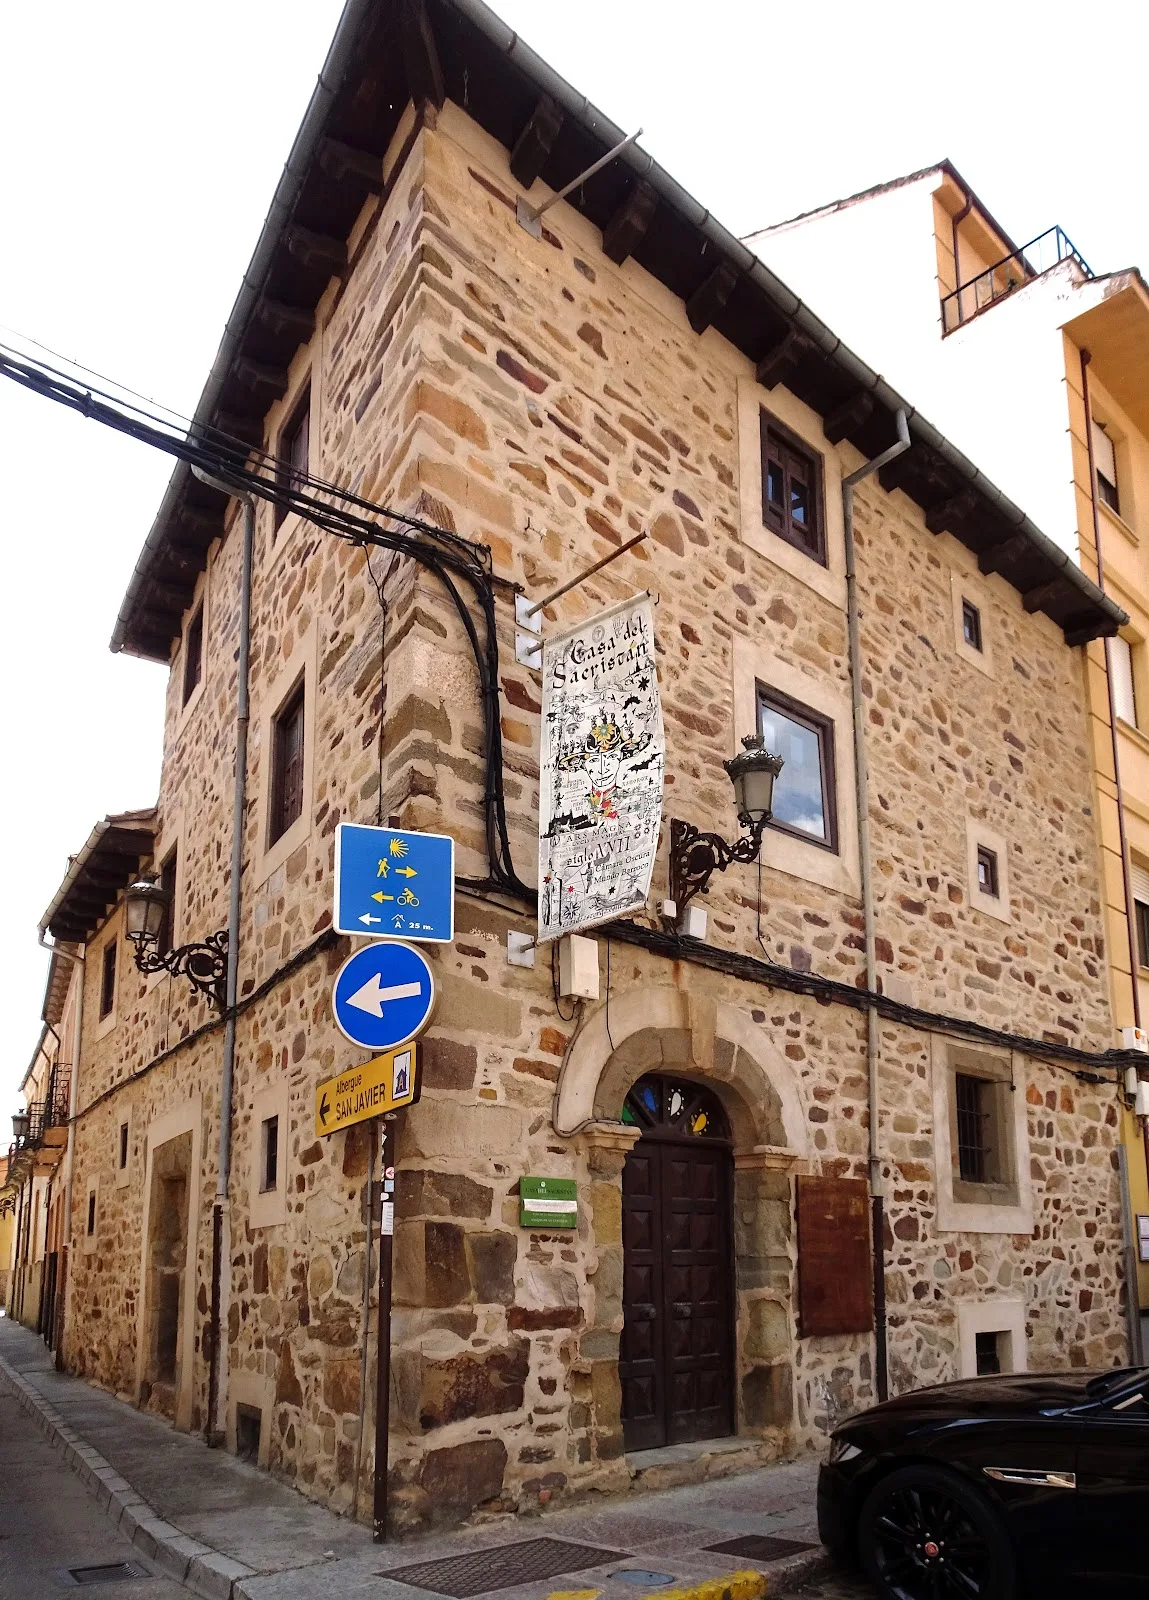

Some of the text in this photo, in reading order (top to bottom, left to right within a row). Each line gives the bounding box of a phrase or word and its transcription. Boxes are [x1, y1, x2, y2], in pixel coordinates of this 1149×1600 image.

[570, 615, 645, 665] Casa del
[552, 640, 650, 689] Sacristán
[566, 821, 632, 843] ARS MAGNA
[566, 847, 594, 868] siglo
[625, 851, 650, 864] Oscura
[594, 862, 649, 885] Mundo Barroco
[335, 1074, 362, 1097] Albergue
[336, 1082, 386, 1121] SAN JAVIER
